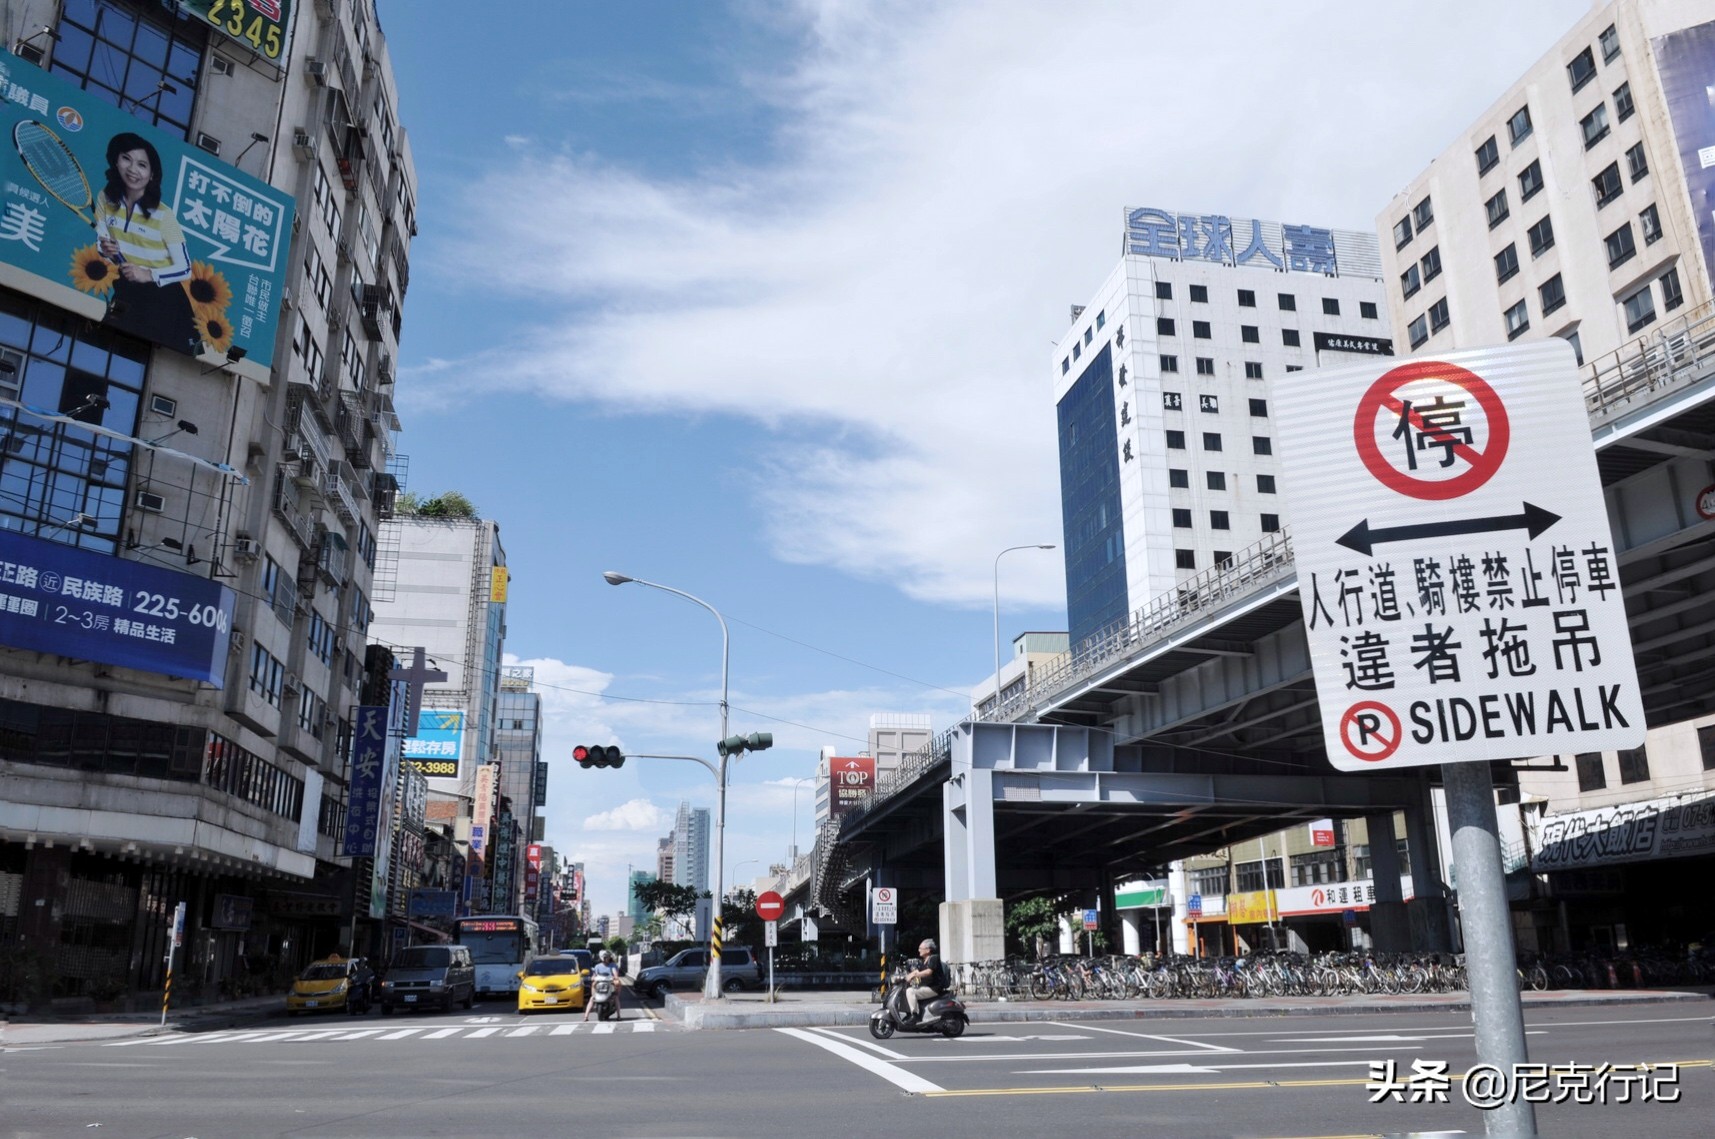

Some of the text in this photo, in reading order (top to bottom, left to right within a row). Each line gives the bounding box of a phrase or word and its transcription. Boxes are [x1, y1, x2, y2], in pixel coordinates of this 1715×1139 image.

[207, 0, 281, 58] 2345
[0, 202, 47, 252] 美
[183, 198, 270, 257] 太陽花
[188, 170, 274, 227] 打不倒的
[1128, 206, 1335, 274] 全球人壽
[1392, 396, 1474, 470] 停
[0, 561, 38, 588] 正路
[61, 576, 123, 607] 民族路
[133, 590, 228, 634] 225-6006
[1309, 541, 1616, 631] 人行道、騎樓禁止停車
[113, 617, 176, 644] 精品生活
[1339, 609, 1602, 691] 違者拖吊
[355, 709, 382, 779] 天安
[1357, 684, 1630, 745] P SIDEWALK
[401, 761, 456, 774] 32-3988
[837, 771, 868, 785] TOP
[1538, 804, 1660, 863] 現代大飯店
[1326, 885, 1377, 905] 和運租車
